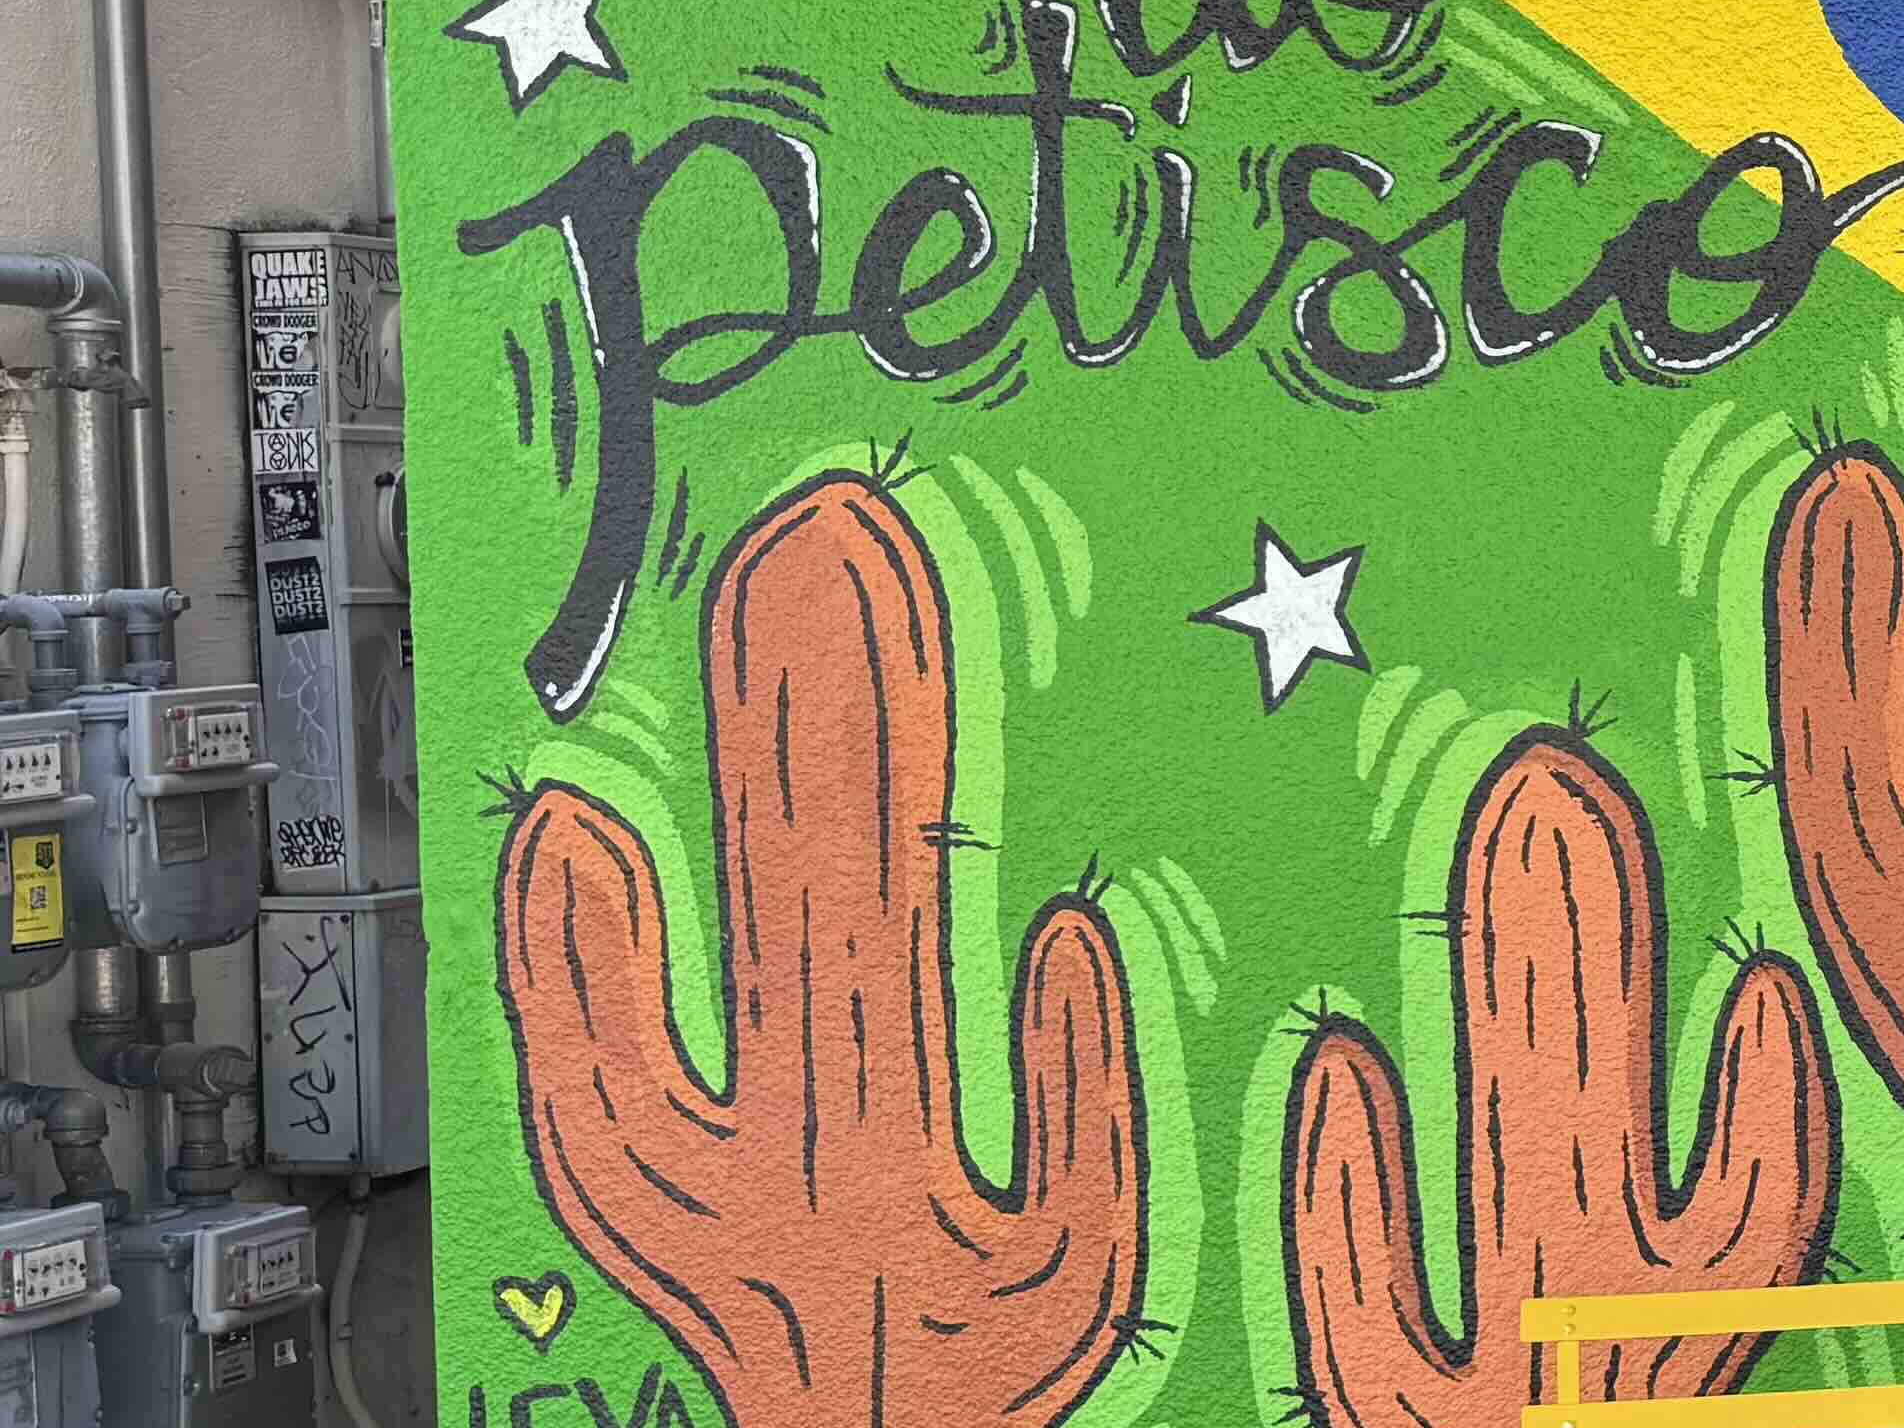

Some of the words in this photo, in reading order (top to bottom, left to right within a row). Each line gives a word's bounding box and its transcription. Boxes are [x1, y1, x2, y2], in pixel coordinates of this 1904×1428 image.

[250, 251, 326, 279] QUAKE
[254, 276, 328, 302] JAWS
[270, 573, 320, 590] DUST2
[272, 587, 323, 604] DUST2
[274, 600, 324, 618] DUST2
